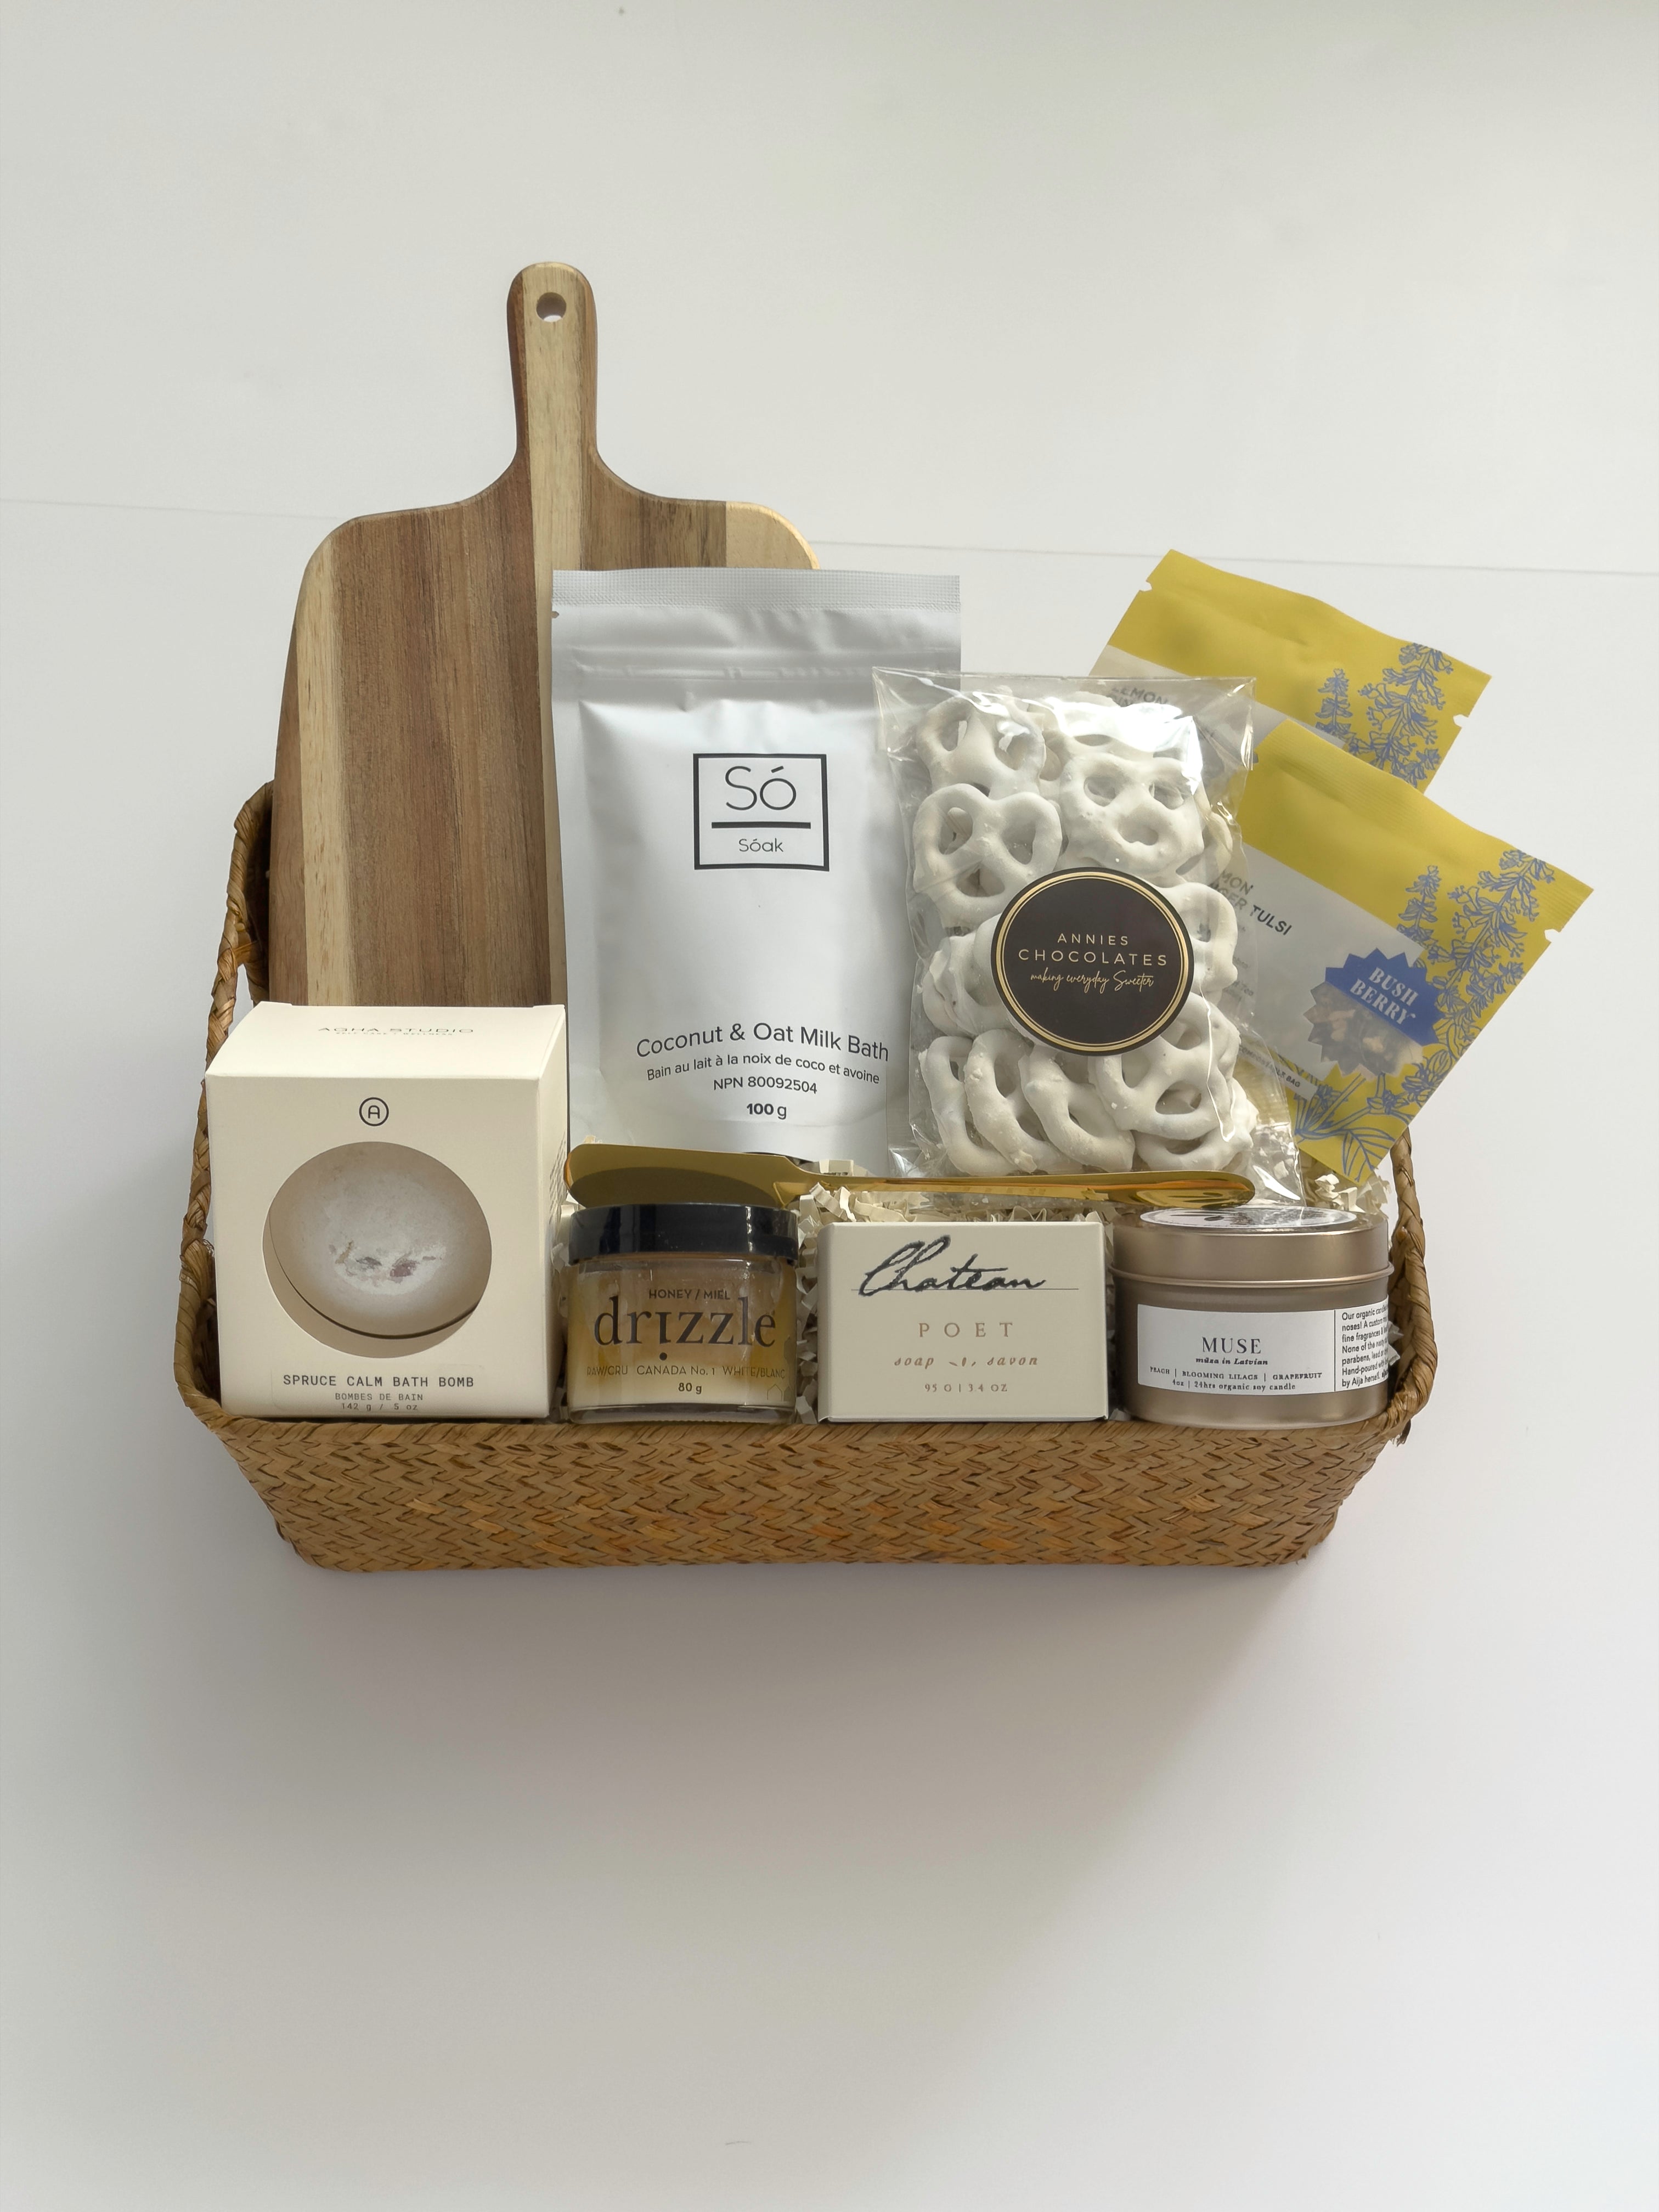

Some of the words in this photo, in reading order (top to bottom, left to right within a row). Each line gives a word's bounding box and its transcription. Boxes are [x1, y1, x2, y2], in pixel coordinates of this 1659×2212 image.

[725, 766, 797, 810] Só
[738, 838, 783, 852] Sóak
[1250, 905, 1292, 935] TULSI
[1057, 933, 1128, 945] ANNIES
[1018, 949, 1166, 966] CHOCOLATES
[1030, 967, 1063, 991] making
[1066, 971, 1109, 994] everyday
[1369, 967, 1418, 1006] BUSH
[1350, 979, 1416, 1024] BERRY
[636, 1026, 723, 1058] Coconut
[730, 1023, 746, 1041] &
[753, 1023, 793, 1042] Oat
[800, 1026, 842, 1051] Milk
[848, 1035, 889, 1062] Bath
[647, 1066, 671, 1081] Bain
[675, 1062, 690, 1074] au
[693, 1056, 712, 1070] lait
[715, 1055, 723, 1066] à
[727, 1054, 738, 1065] la
[743, 1053, 771, 1064] noix
[775, 1054, 792, 1066] de
[795, 1058, 825, 1071] coco
[828, 1064, 840, 1075] et
[843, 1067, 880, 1084] avoine
[714, 1076, 743, 1091] NPN
[748, 1076, 817, 1094] 80092504
[1286, 1076, 1301, 1087] BAG
[747, 1103, 774, 1115] 100
[777, 1106, 787, 1120] g
[649, 1289, 691, 1299] HONEY
[704, 1290, 730, 1300] MIEL
[1342, 1312, 1355, 1321] Our
[1356, 1308, 1375, 1320] organic
[594, 1296, 776, 1361] drizzle
[919, 1323, 1013, 1338] POET
[1342, 1321, 1362, 1331] noses!
[1363, 1321, 1368, 1329] A
[1342, 1334, 1354, 1342] fine
[1356, 1330, 1380, 1342] fragrances
[1202, 1337, 1261, 1354] MUSE
[1342, 1346, 1359, 1354] None
[1361, 1342, 1367, 1351] of
[1367, 1341, 1375, 1350] the
[894, 1357, 934, 1369] soap
[987, 1357, 1038, 1366] savon
[1342, 1354, 1370, 1367] parabens,
[586, 1365, 628, 1376] RAW/CRU
[637, 1365, 686, 1375] CANADA
[691, 1365, 708, 1375] No.
[723, 1365, 786, 1379] WHITE/BLANC
[1150, 1366, 1170, 1375] PEACH
[1182, 1371, 1224, 1379] BLOOMING
[1273, 1372, 1323, 1380] GRAPEFRUIT
[1342, 1362, 1378, 1376] Hand-poured
[283, 1375, 336, 1386] SPRUCE
[347, 1376, 382, 1387] CALM
[393, 1376, 428, 1387] BATH
[439, 1377, 474, 1387] BOMB
[924, 1384, 937, 1392] 95
[1194, 1380, 1216, 1389] 24hrs
[1219, 1383, 1249, 1391] organic
[1342, 1378, 1350, 1389] by
[1352, 1377, 1363, 1387] Aija
[678, 1383, 692, 1392] 80
[696, 1385, 702, 1394] g
[335, 1392, 373, 1401] BOMBES
